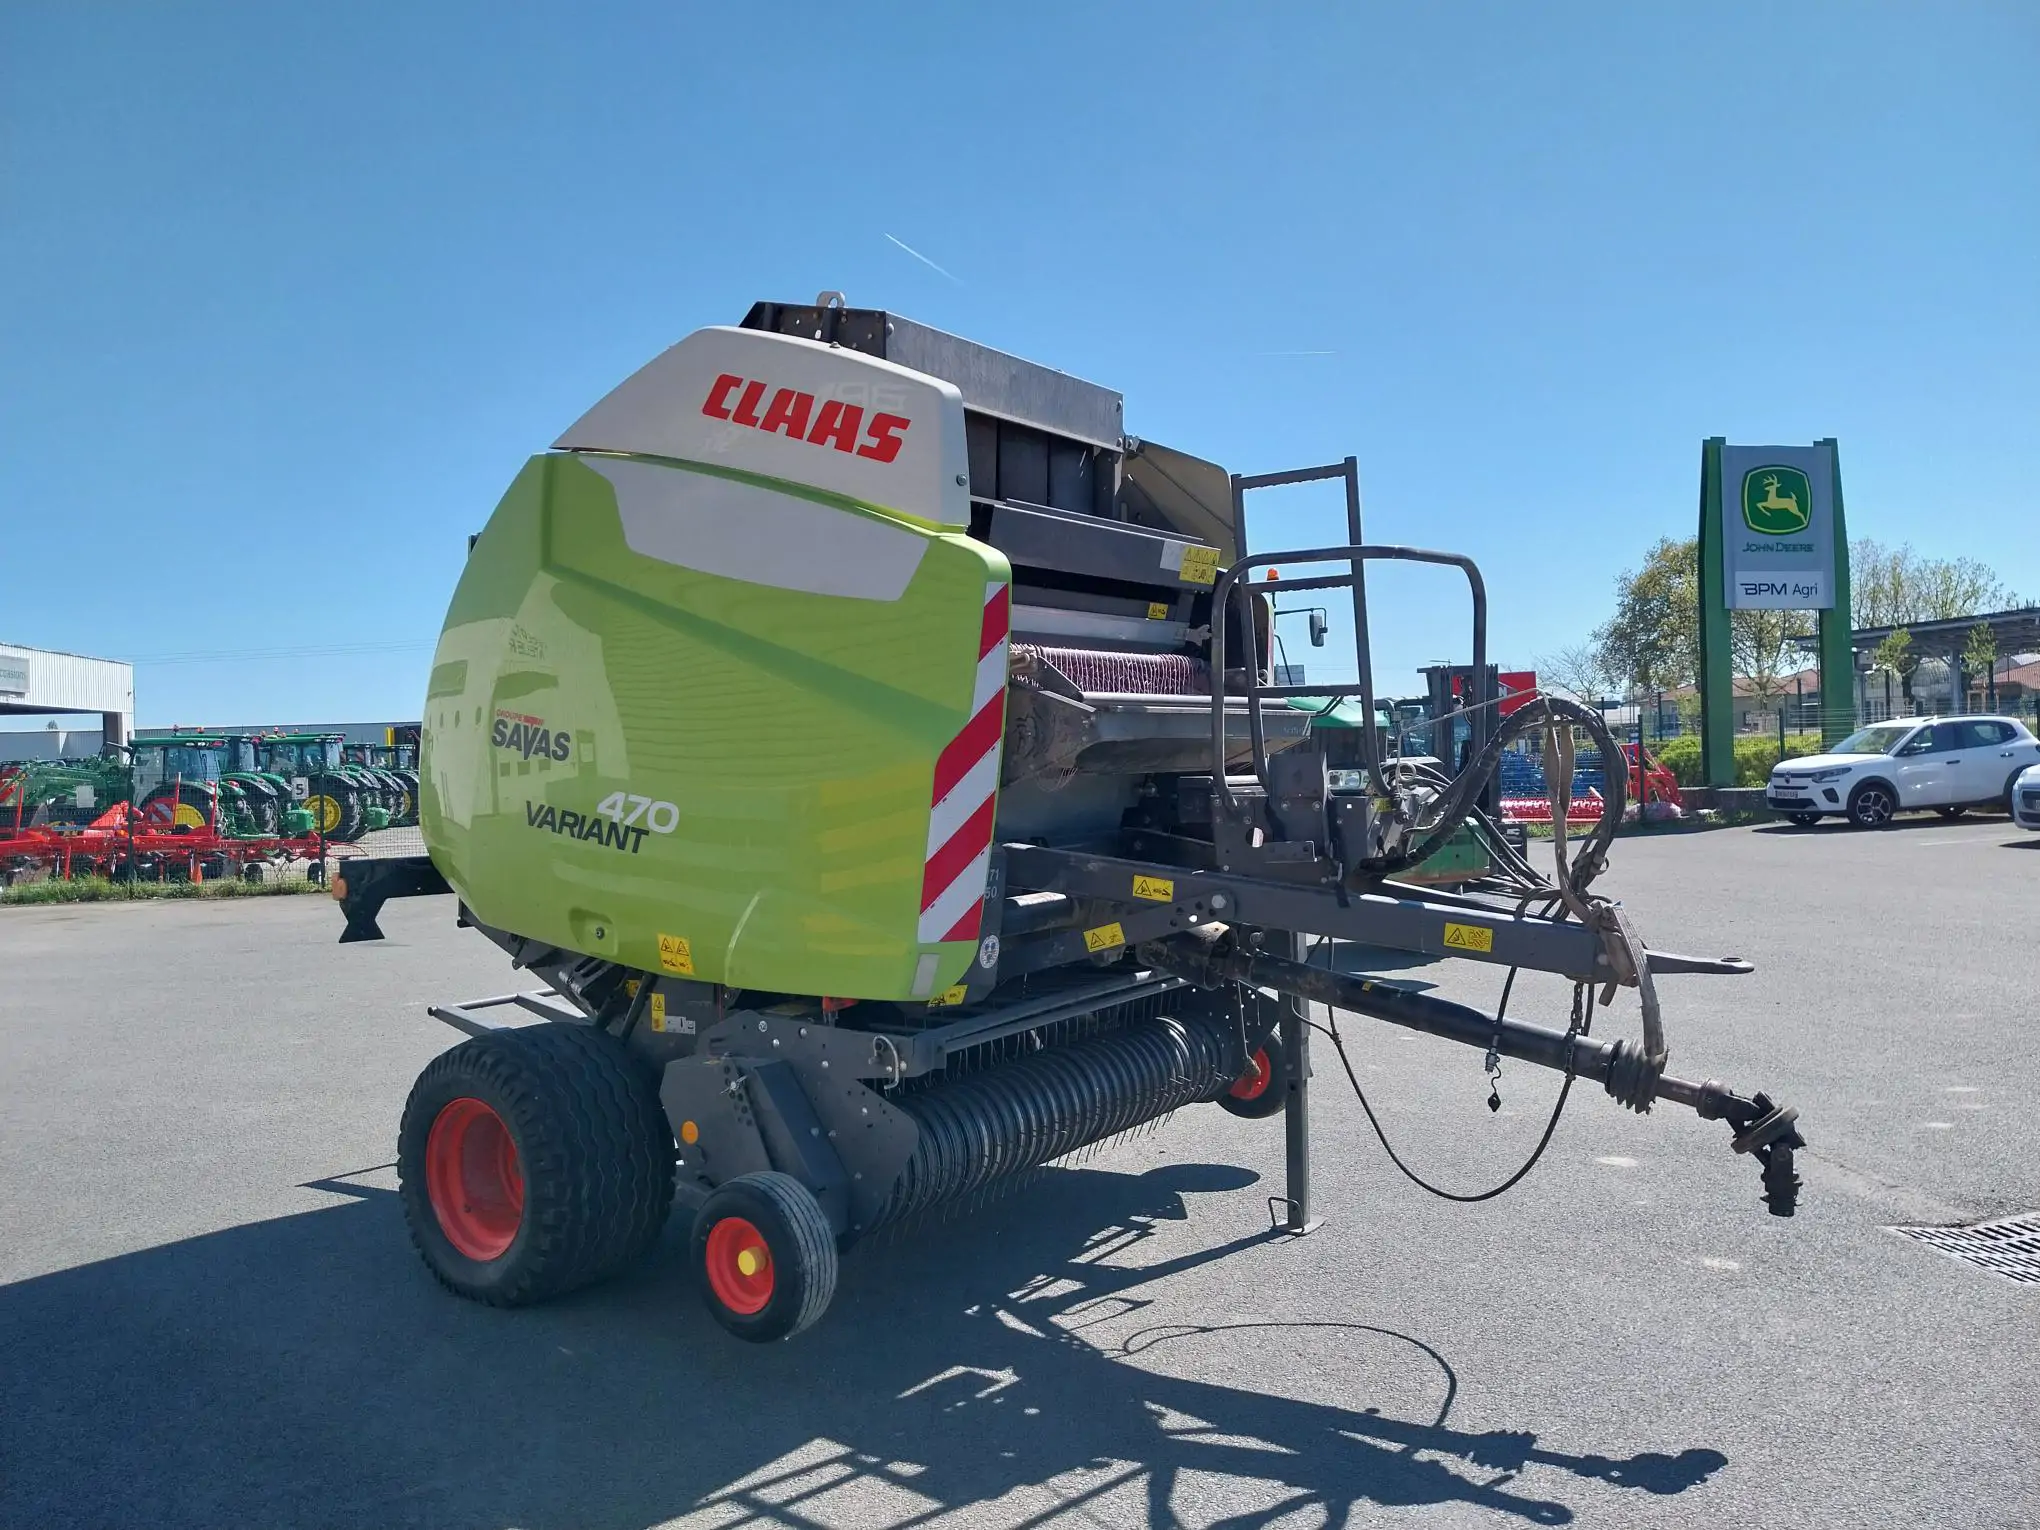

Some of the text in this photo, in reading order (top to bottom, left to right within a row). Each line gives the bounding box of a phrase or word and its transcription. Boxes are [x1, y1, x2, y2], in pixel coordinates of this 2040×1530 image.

[702, 373, 911, 464] CLAAS
[1742, 541, 1815, 552] JOHN DEERE
[1740, 583, 1818, 598] BPM Agri
[491, 718, 571, 762] SAVAS
[296, 783, 304, 795] 5
[526, 800, 650, 853] VARIANT
[597, 791, 679, 834] 470
